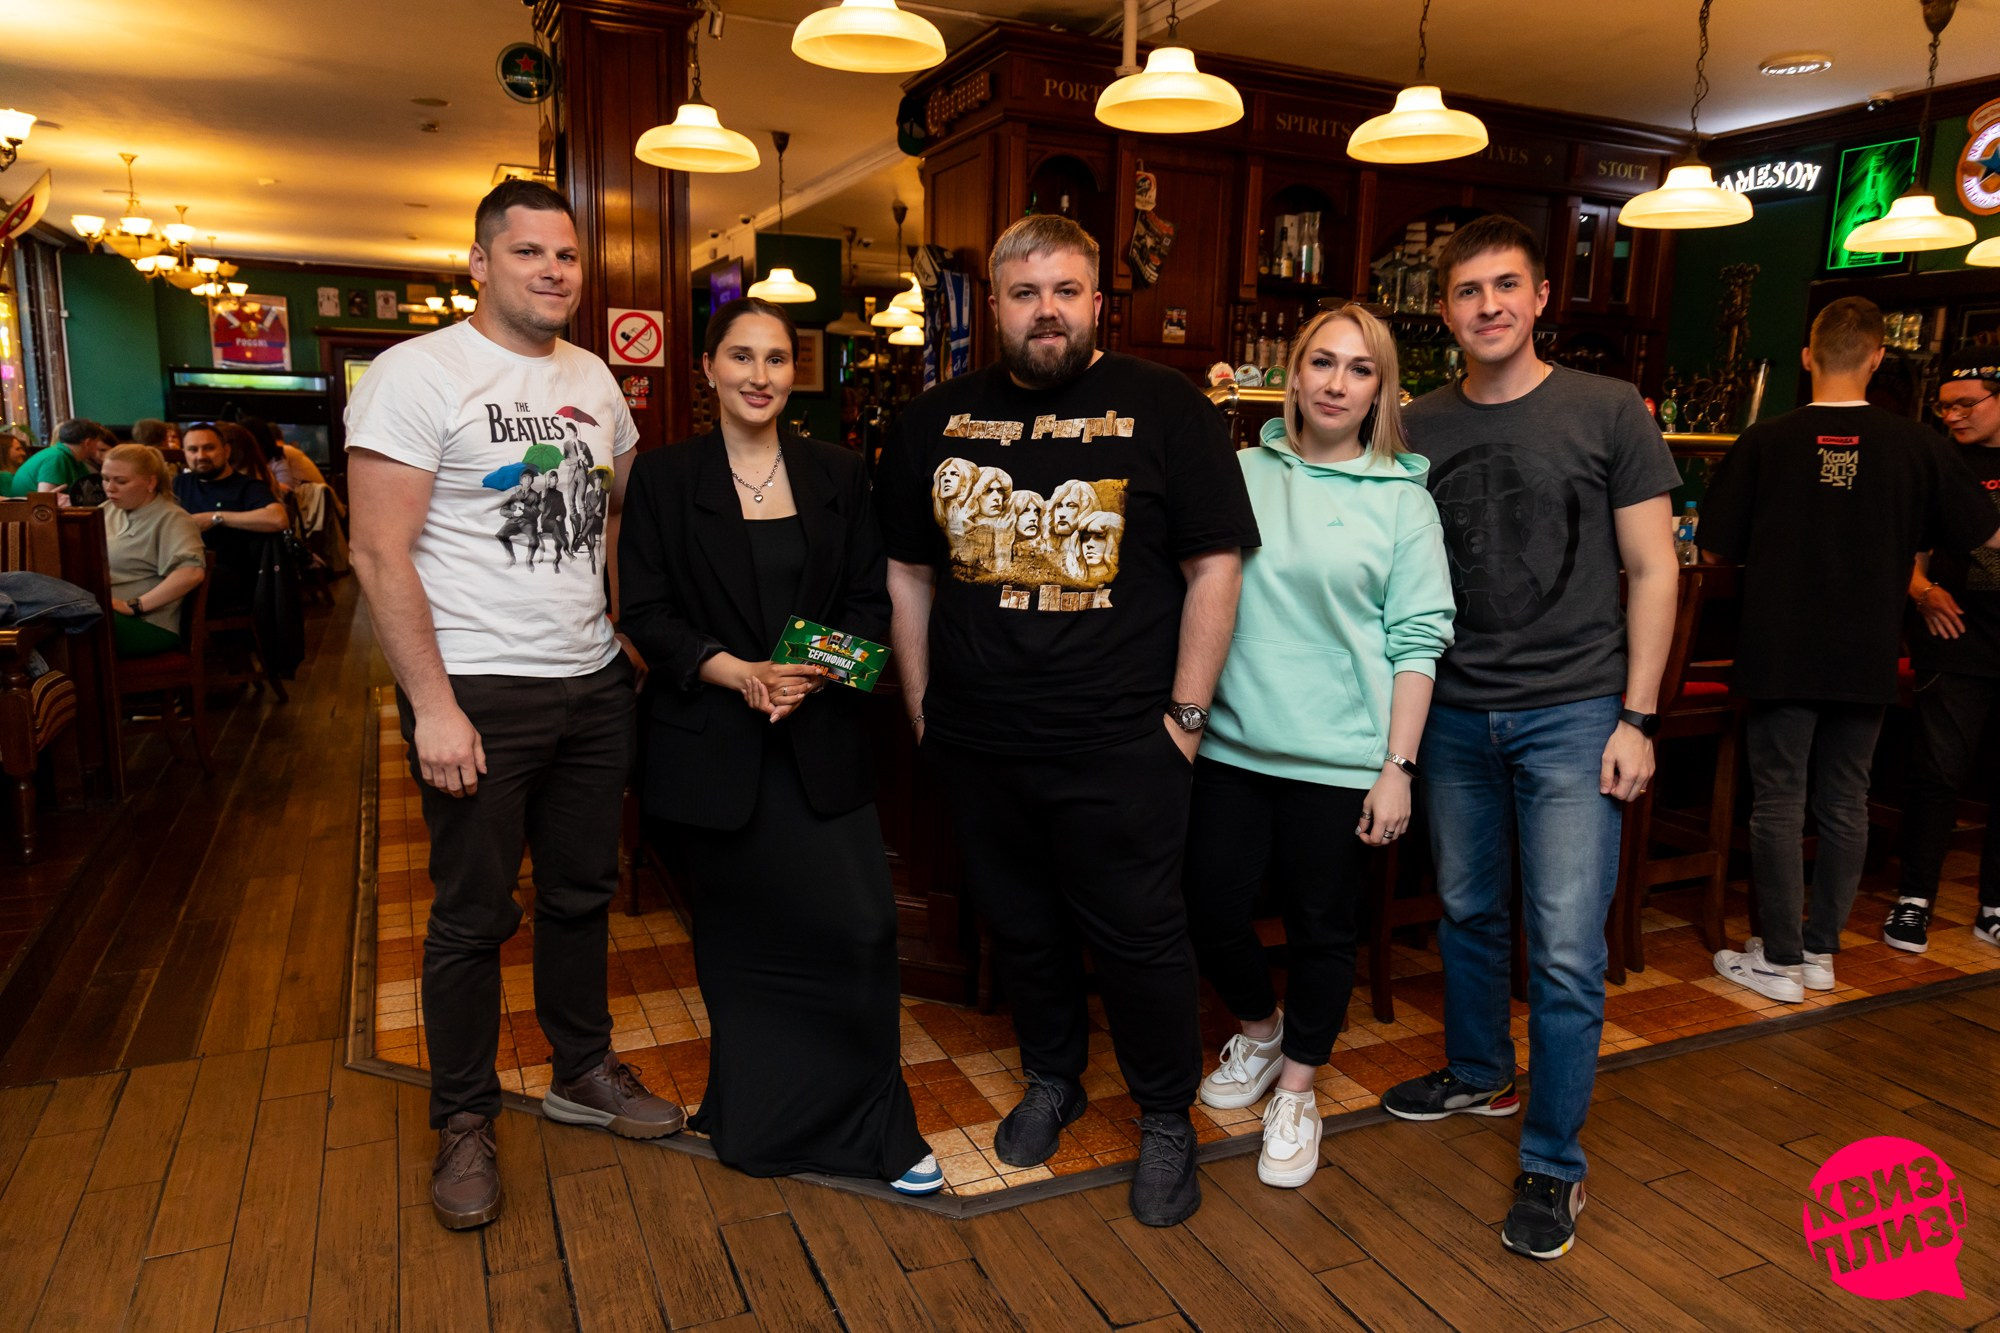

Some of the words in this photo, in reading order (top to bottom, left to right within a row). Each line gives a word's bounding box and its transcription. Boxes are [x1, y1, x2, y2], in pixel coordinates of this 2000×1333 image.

[1276, 113, 1352, 140] SPIRITS
[1477, 144, 1529, 165] INES
[1598, 160, 1648, 181] STOUT
[1712, 161, 1822, 193] AMESON
[514, 402, 530, 412] THE
[484, 403, 565, 446] BEATLES
[1031, 410, 1135, 443] Purple
[808, 648, 856, 670] СЕРТИФИКАТ
